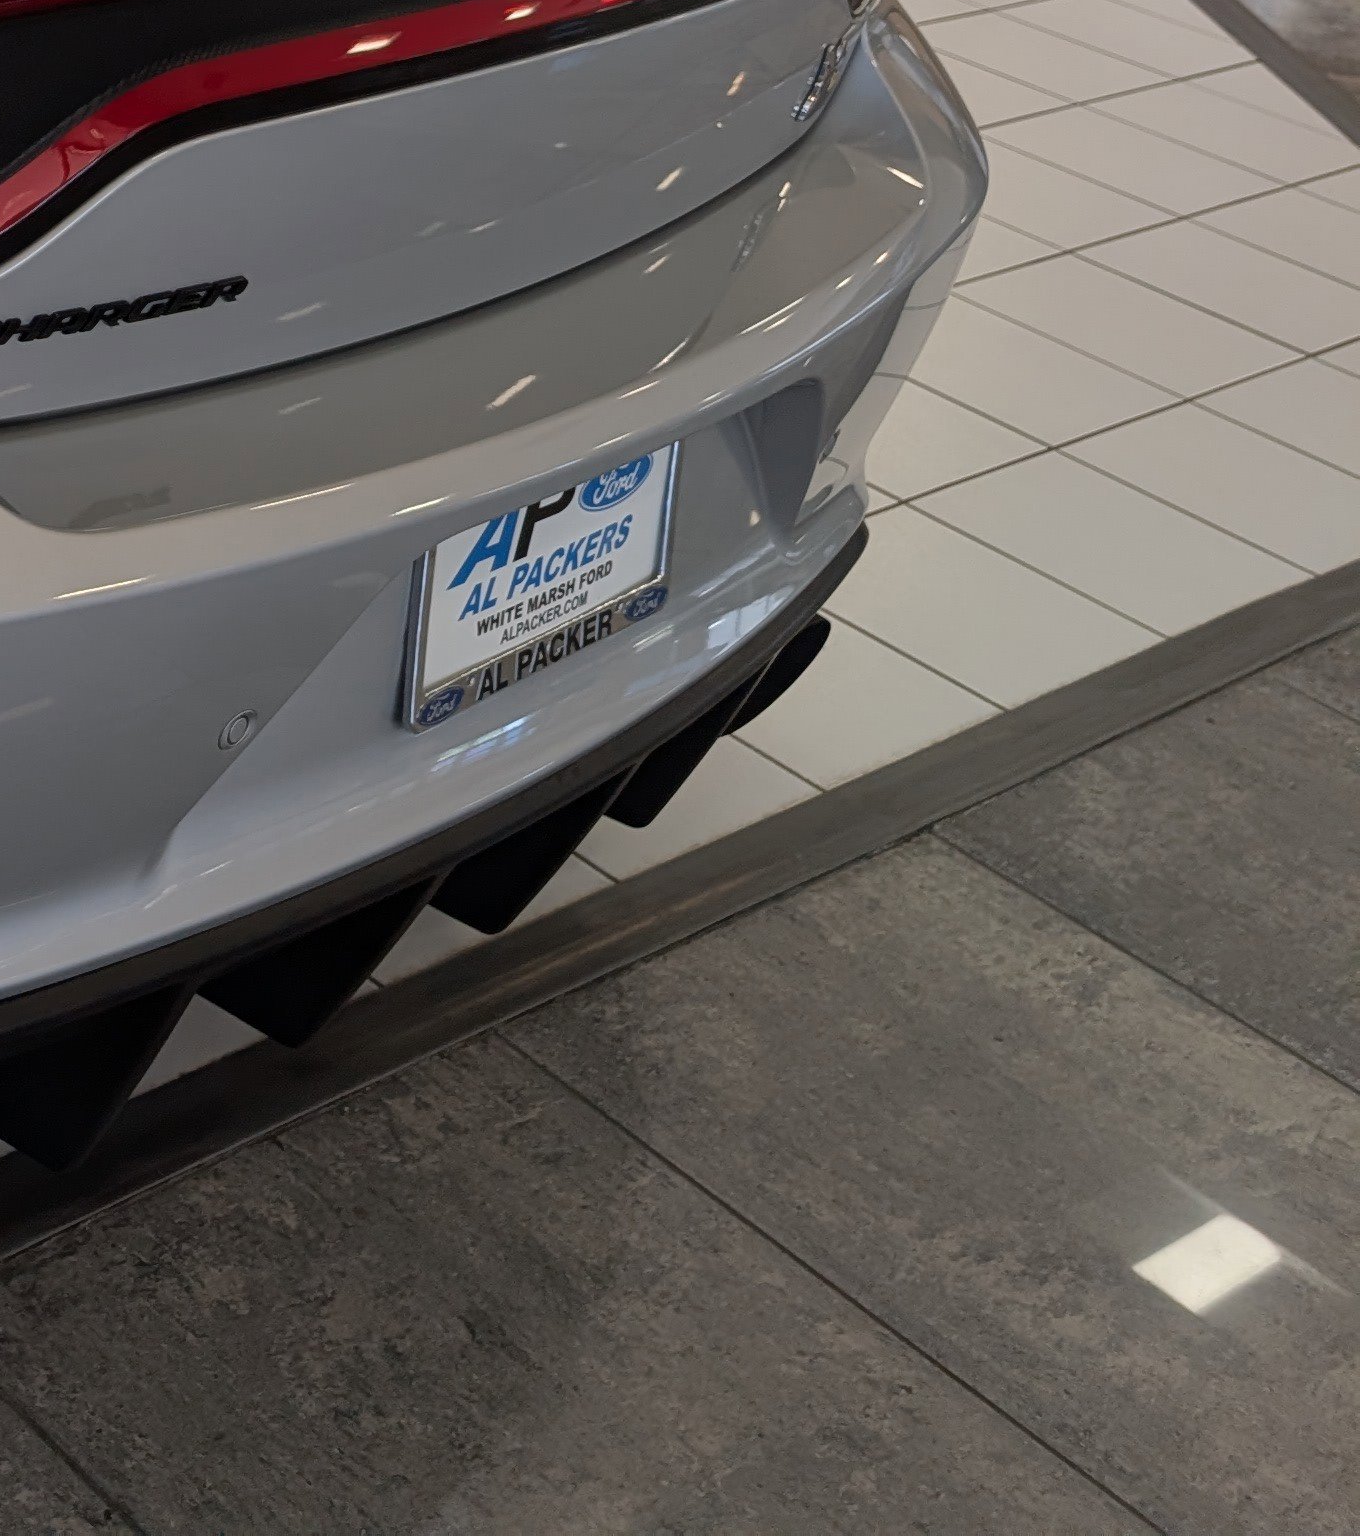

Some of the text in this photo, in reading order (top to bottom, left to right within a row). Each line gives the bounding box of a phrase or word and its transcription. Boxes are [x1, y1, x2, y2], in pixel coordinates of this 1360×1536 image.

[446, 486, 577, 591] AP
[457, 576, 498, 622] AL
[476, 560, 613, 637] WHITE MARSH FORD
[499, 590, 589, 645] ALPACKER.COM
[478, 661, 509, 701] AL
[515, 609, 613, 682] PACKER
